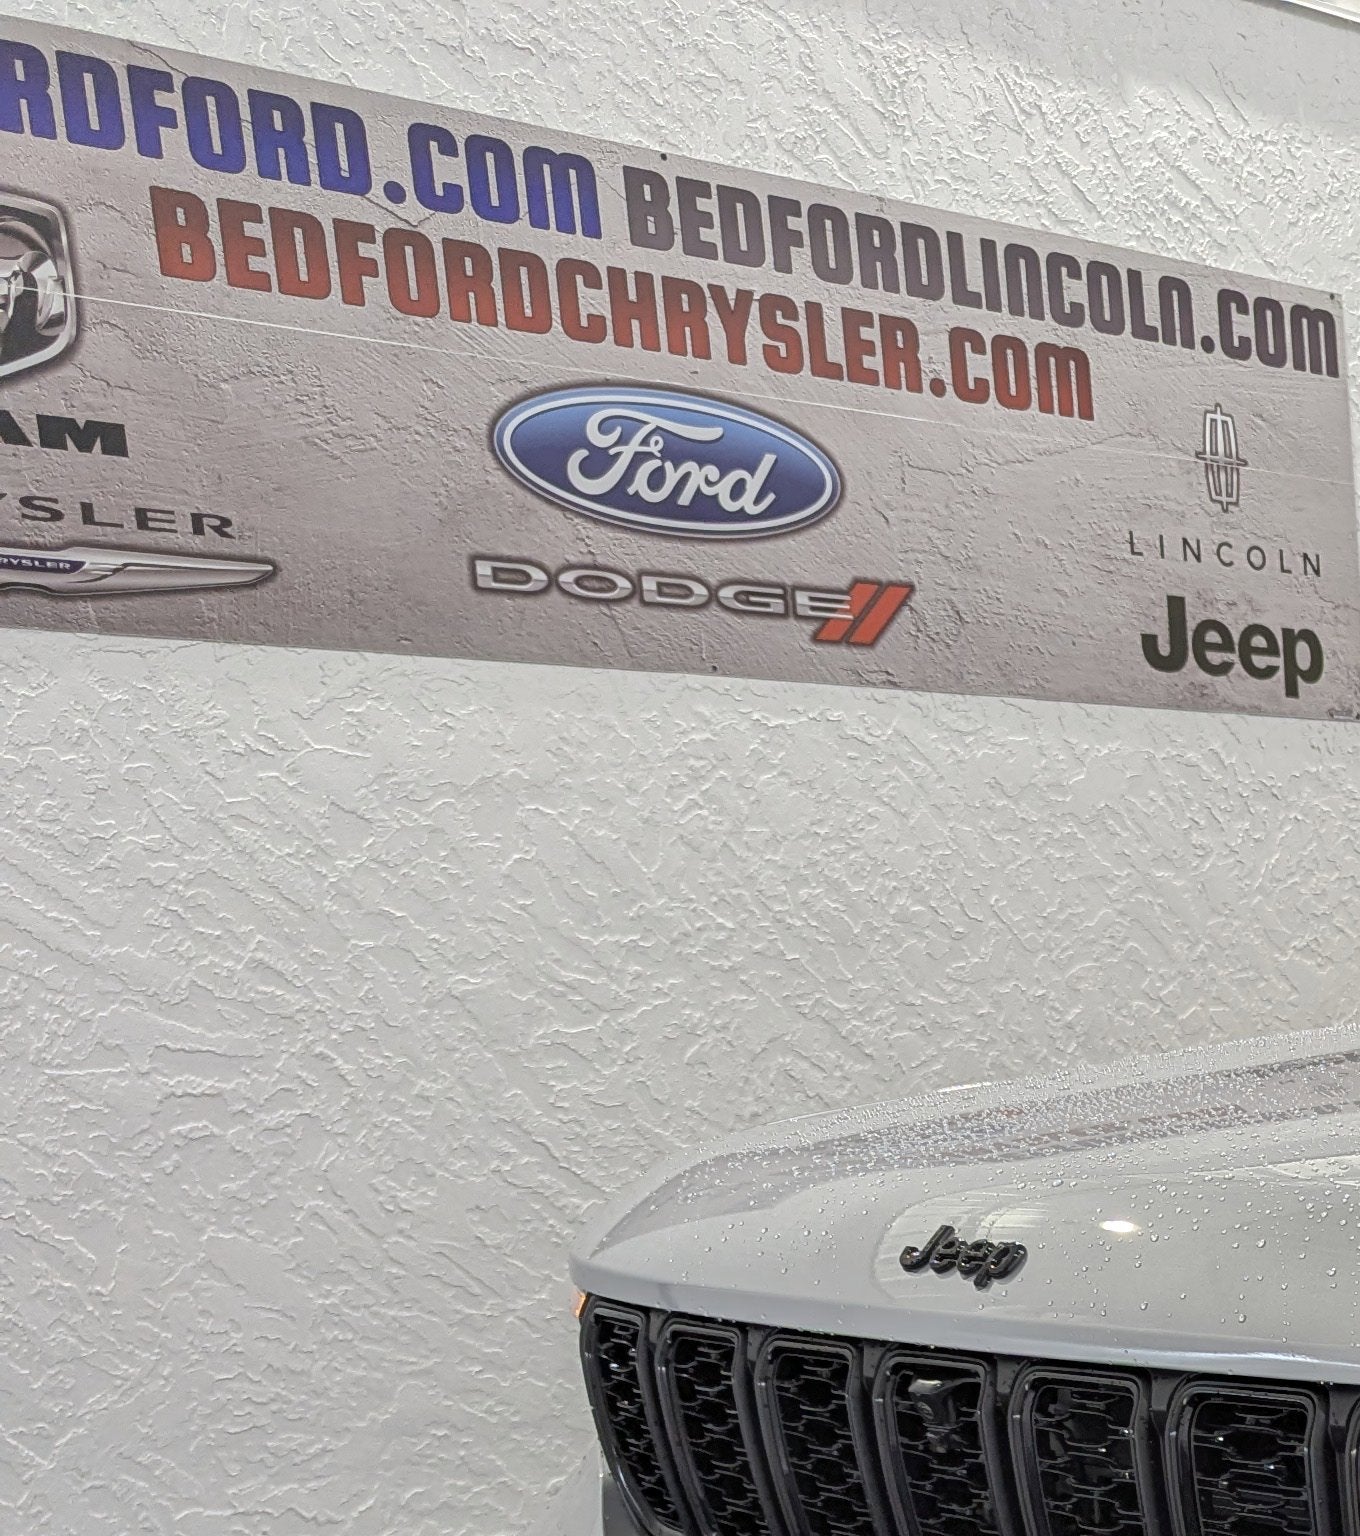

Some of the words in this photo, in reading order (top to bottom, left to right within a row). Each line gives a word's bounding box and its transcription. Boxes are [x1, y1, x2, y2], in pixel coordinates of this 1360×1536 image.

[149, 186, 1095, 422] BEDFORDCHRYSLER.COM
[622, 166, 1340, 379] BEDFORDLINCOLN.COM
[566, 406, 780, 517] Ford
[0, 492, 237, 540] SLER
[1128, 530, 1323, 579] LINCOLN
[473, 558, 857, 621] DODGE
[1140, 595, 1325, 699] Jeep
[898, 1224, 1029, 1291] Jeep
